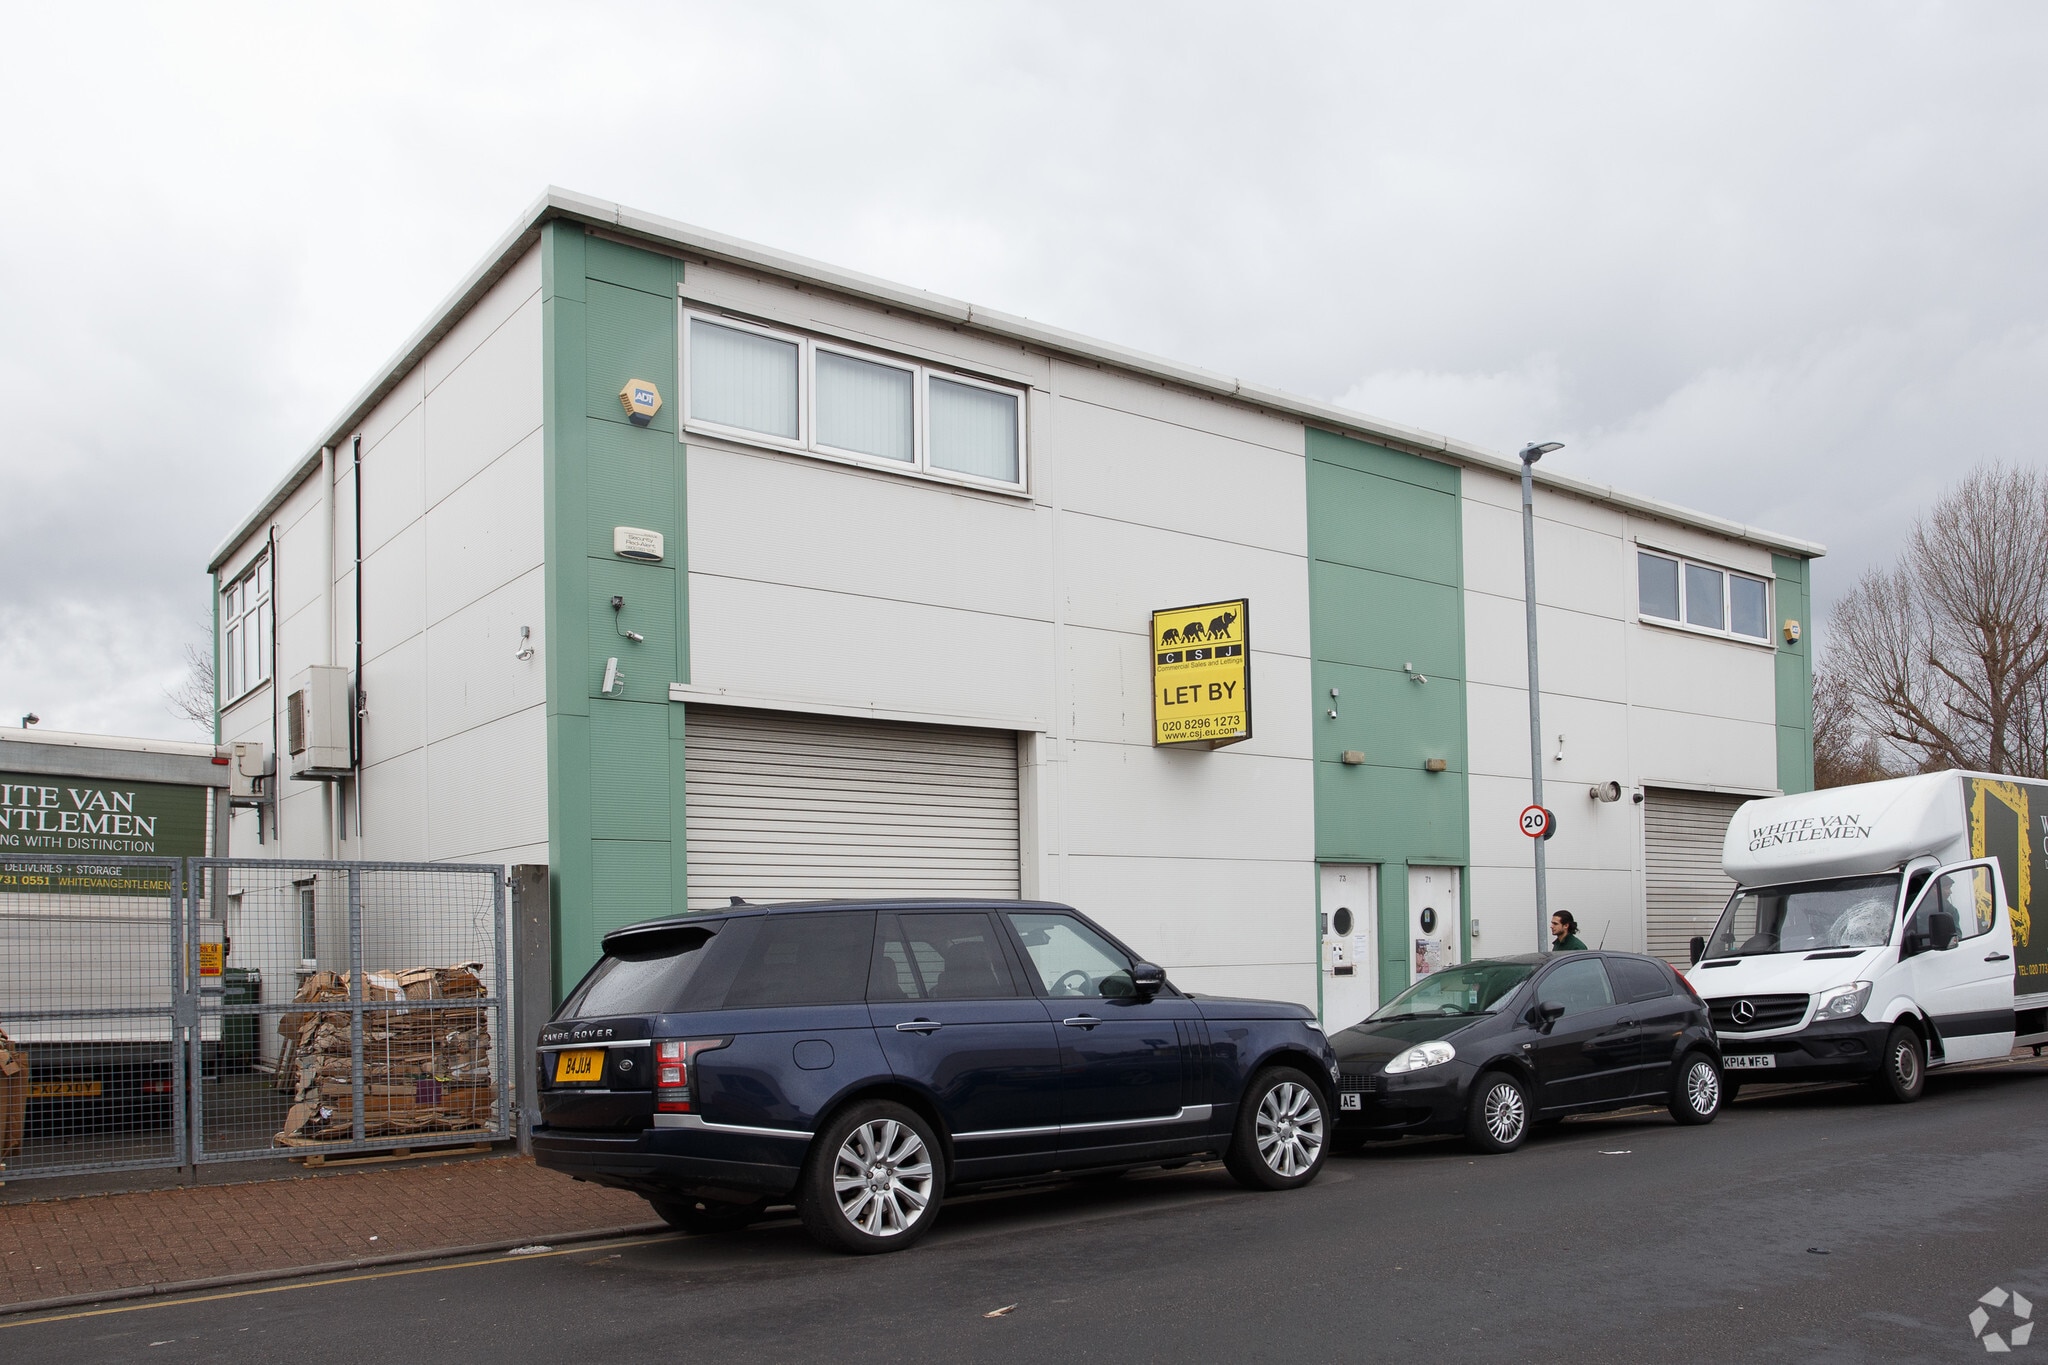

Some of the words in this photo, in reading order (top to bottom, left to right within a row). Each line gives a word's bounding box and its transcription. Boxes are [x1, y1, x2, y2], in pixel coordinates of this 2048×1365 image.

[635, 391, 654, 403] ADT
[1166, 653, 1175, 663] C
[1195, 650, 1203, 660] S
[1225, 646, 1232, 656] J
[1157, 663, 1189, 673] Commercial
[1191, 661, 1206, 669] Sales
[1220, 657, 1243, 665] Lettings
[1164, 684, 1202, 706] LET
[1209, 680, 1237, 701] BY
[1162, 721, 1182, 732] 020
[1184, 717, 1211, 730] 8296
[1214, 715, 1240, 727] 1273
[1165, 727, 1238, 739] www.csj.eu.com
[67, 788, 135, 813] VAN
[1524, 814, 1543, 828] 20
[1753, 818, 1815, 839] WHITE
[1820, 814, 1860, 827] VAN
[25, 836, 62, 848] WITH
[67, 838, 155, 852] DISTINCTION
[1748, 826, 1872, 852] GENTLEMEN
[5, 863, 62, 874] DELIVERIES
[76, 865, 122, 876] STORAGE
[22, 875, 50, 886] 0551
[543, 1032, 569, 1041] RANGE
[574, 1028, 613, 1039] ROVER
[1748, 1056, 1769, 1067] WFG
[1340, 1096, 1356, 1107] AE
